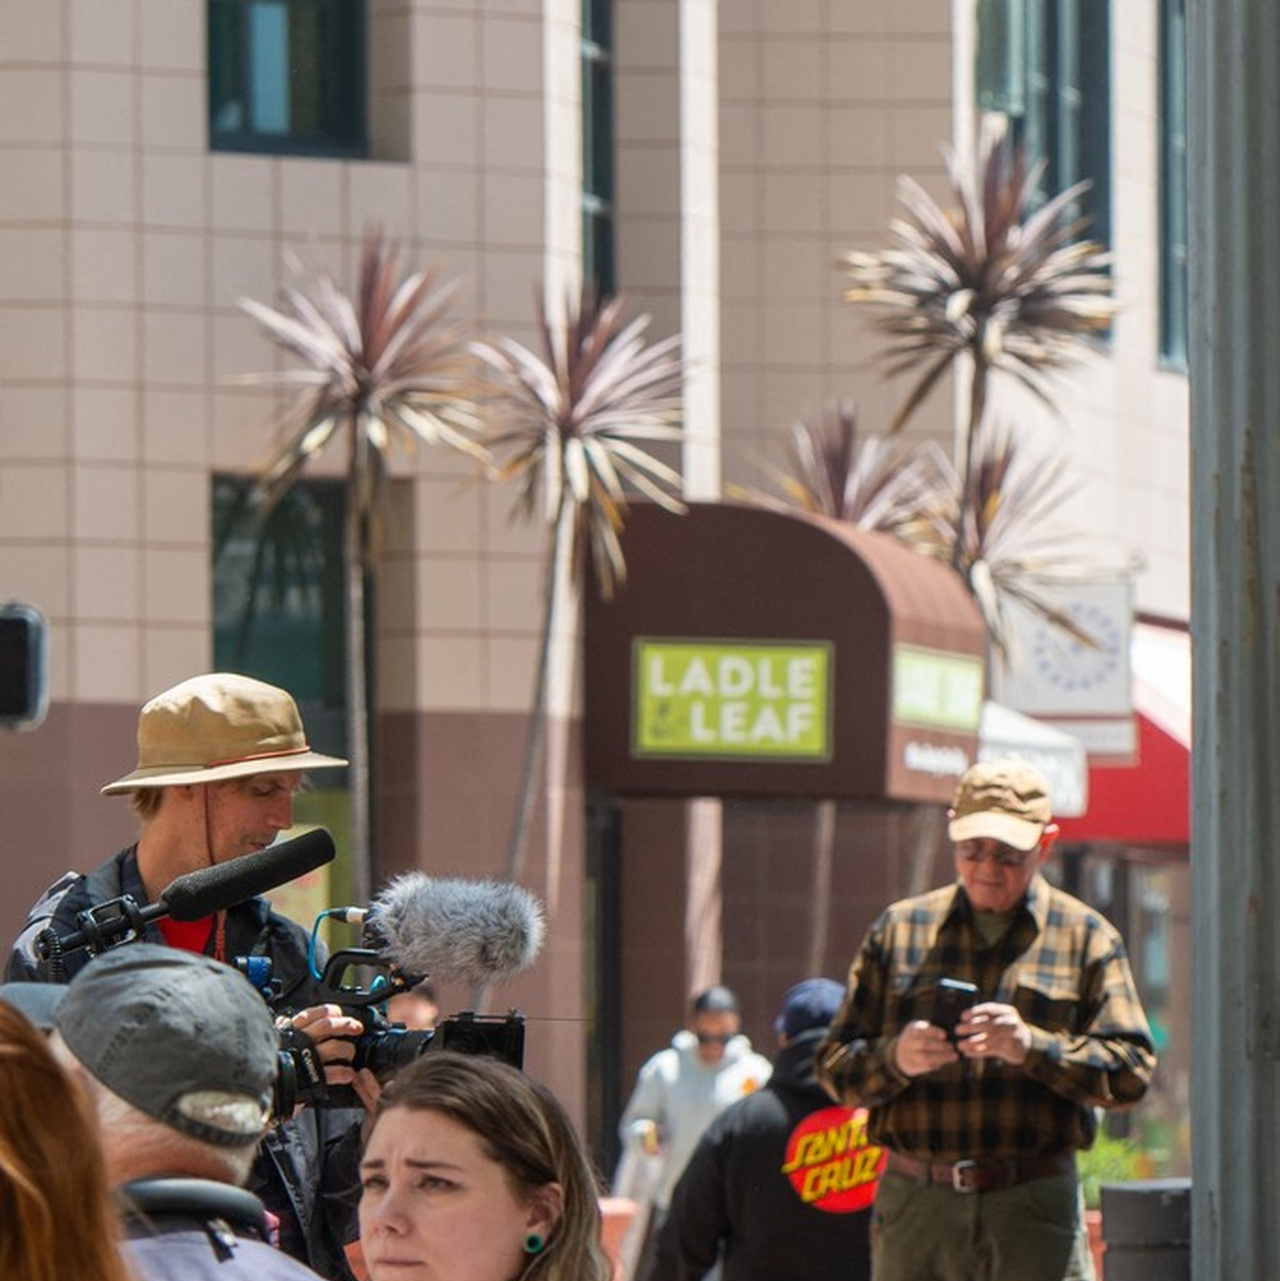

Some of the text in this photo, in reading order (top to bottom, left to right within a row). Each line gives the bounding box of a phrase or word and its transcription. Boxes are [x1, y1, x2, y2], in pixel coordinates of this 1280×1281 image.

[650, 654, 816, 699] LADLE
[690, 701, 814, 743] LEAF
[800, 1145, 882, 1203] CRUZ
